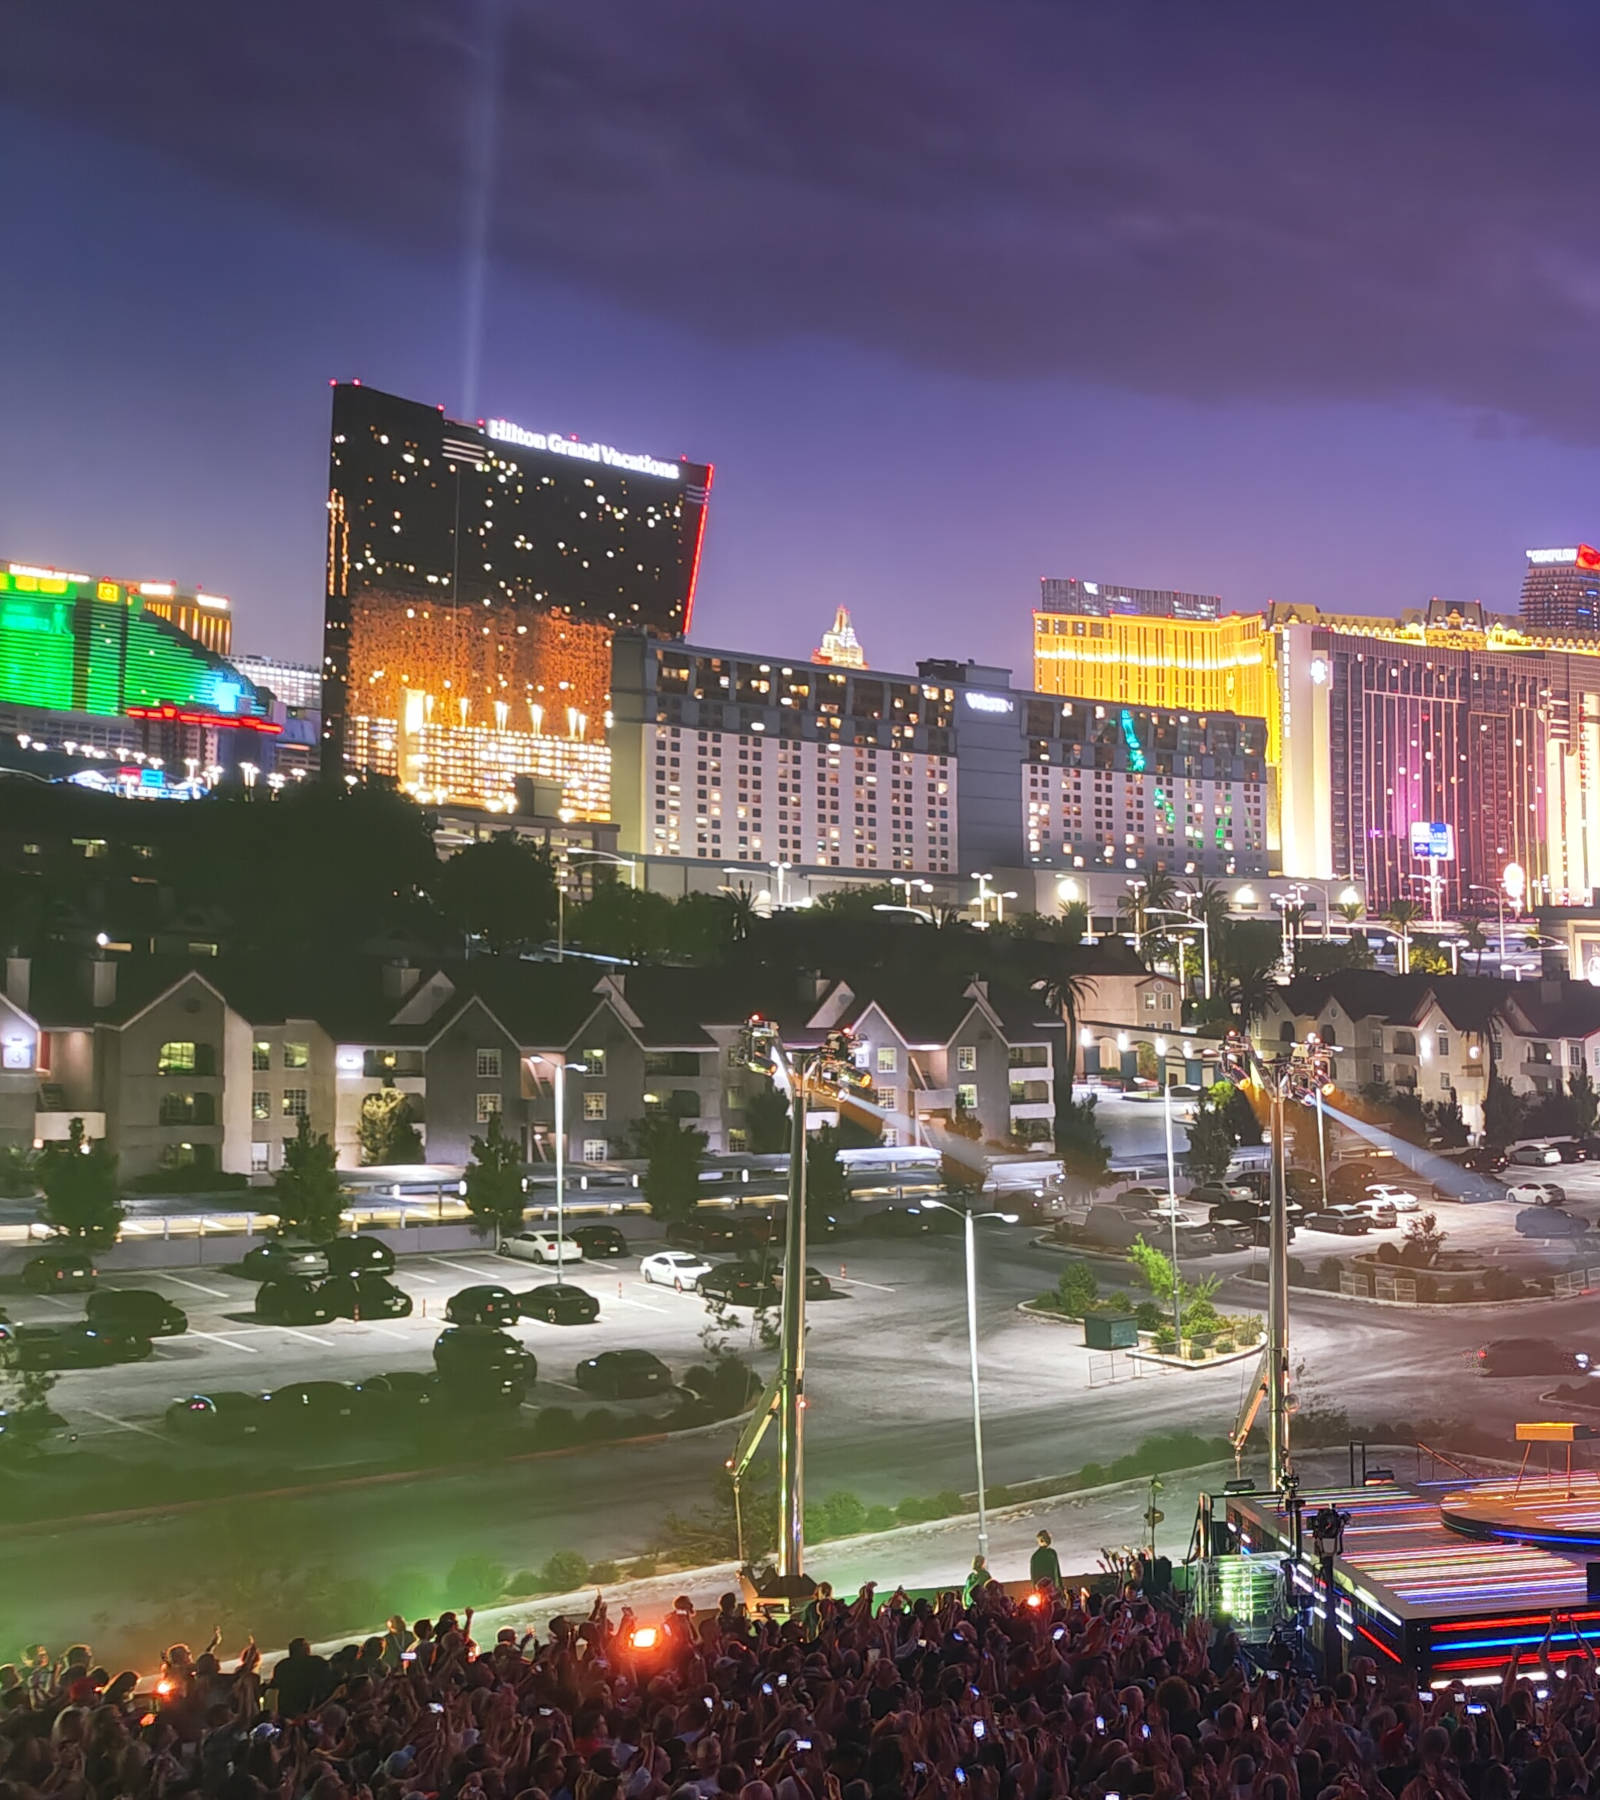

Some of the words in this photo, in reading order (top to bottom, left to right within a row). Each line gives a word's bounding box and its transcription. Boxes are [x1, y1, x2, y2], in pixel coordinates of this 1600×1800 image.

[488, 418, 547, 450] Hilton
[548, 433, 601, 463] Grand
[600, 443, 681, 480] Vacations
